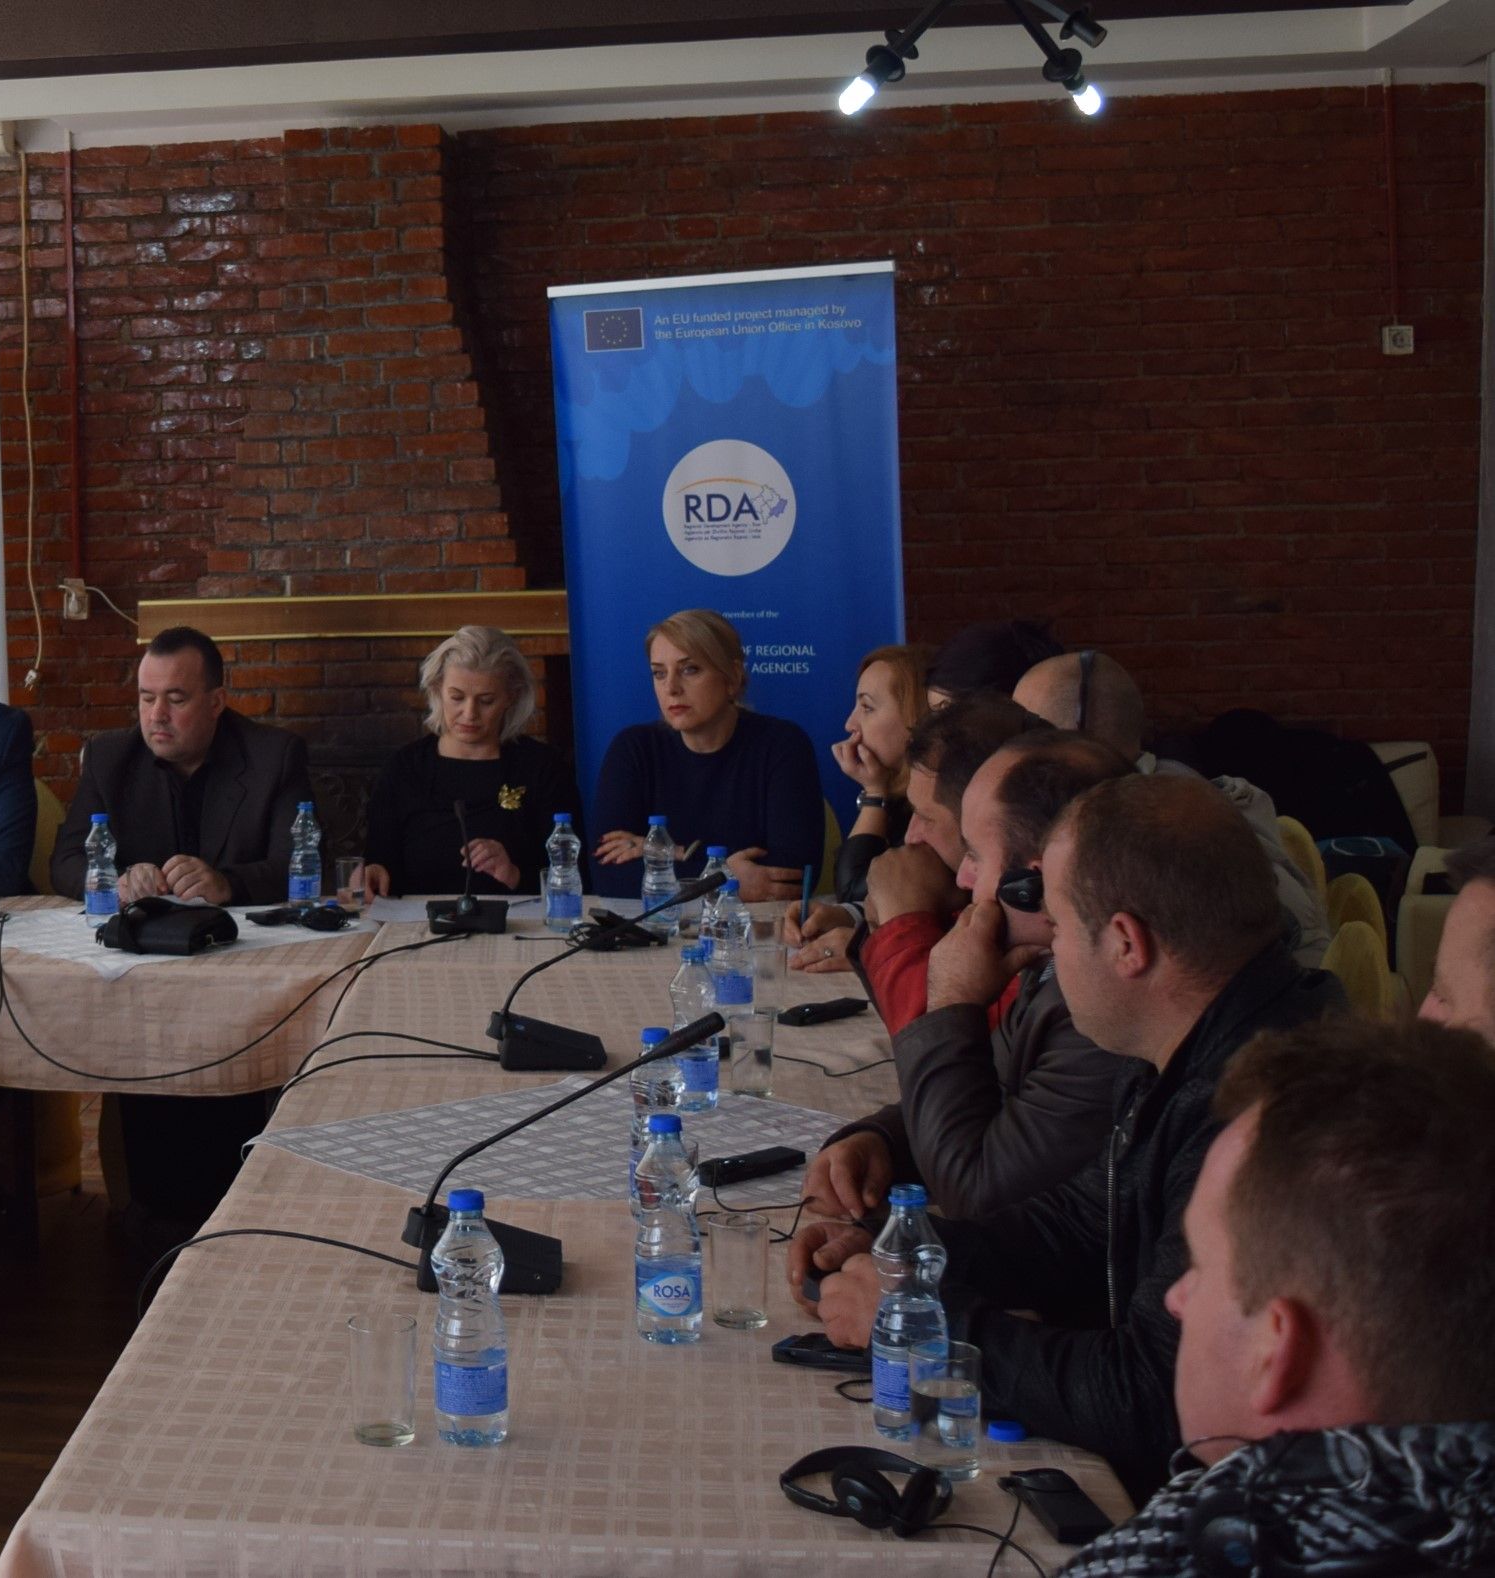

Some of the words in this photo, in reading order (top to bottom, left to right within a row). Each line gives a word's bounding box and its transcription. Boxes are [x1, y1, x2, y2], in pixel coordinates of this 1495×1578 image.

[655, 315, 669, 325] An
[672, 314, 689, 324] EU
[692, 311, 731, 322] funded
[734, 309, 772, 321] project
[775, 305, 828, 318] managed
[831, 304, 846, 316] by
[655, 329, 672, 339] the
[675, 326, 729, 339] European
[732, 323, 765, 334] Union
[768, 321, 802, 332] Office
[805, 319, 815, 329] in
[818, 318, 862, 328] Kosovo
[685, 493, 759, 522] RDA
[756, 610, 763, 618] of
[766, 610, 779, 618] the
[756, 645, 816, 656] REGIONAL
[751, 662, 810, 674] AGENCIES
[654, 1284, 690, 1298] ROSA
